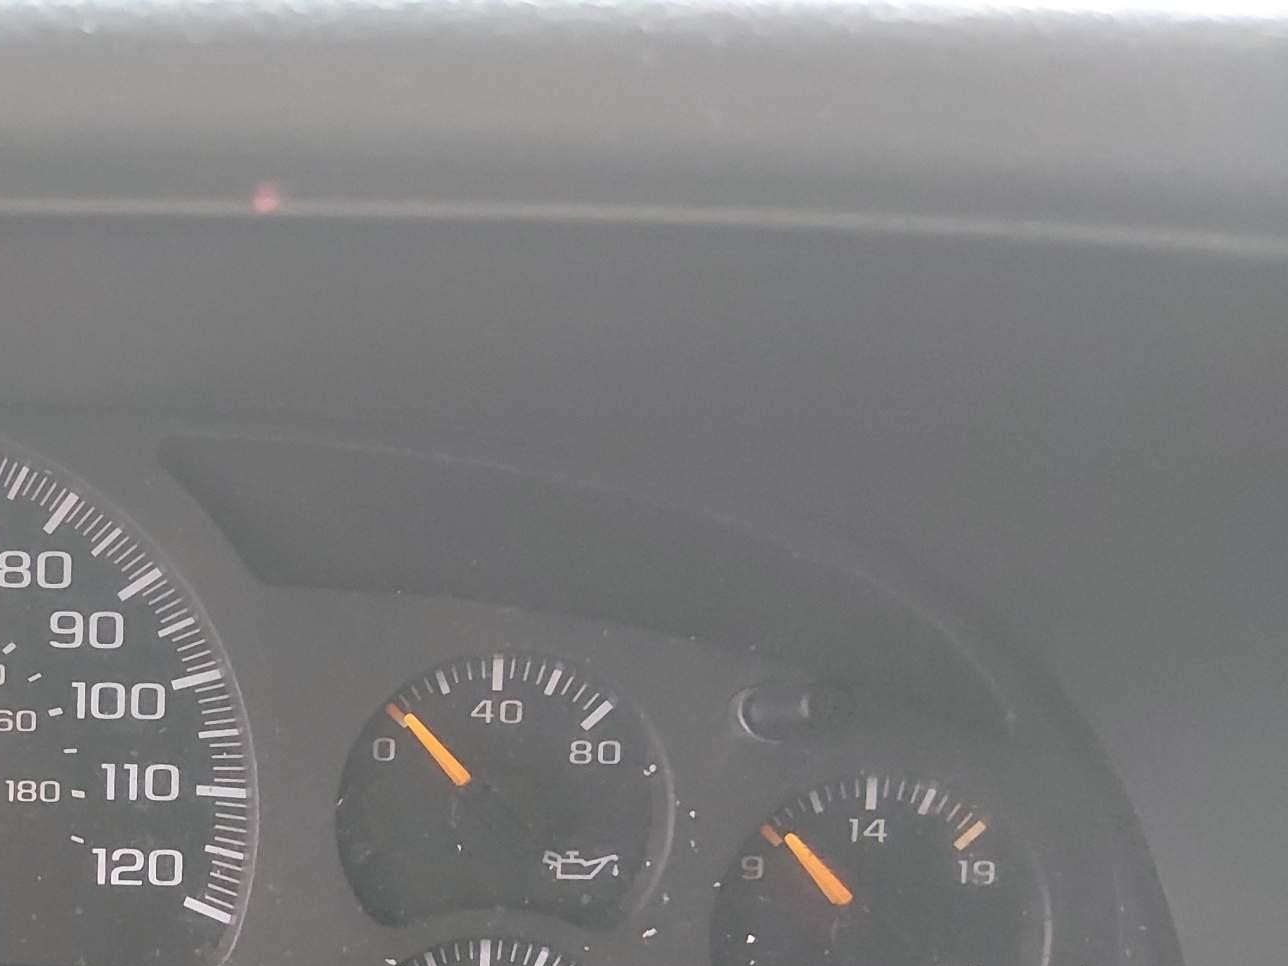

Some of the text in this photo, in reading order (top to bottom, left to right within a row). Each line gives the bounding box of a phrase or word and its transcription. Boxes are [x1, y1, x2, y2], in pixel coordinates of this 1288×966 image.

[49, 611, 125, 648] 90
[71, 682, 166, 720] 100
[471, 700, 523, 724] 40
[372, 737, 395, 761] 0
[569, 740, 621, 764] 80
[5, 780, 61, 802] 180
[100, 763, 180, 801] 110
[849, 818, 888, 843] 14
[92, 848, 183, 886] 120
[741, 856, 763, 880] 9
[958, 860, 996, 885] 19
